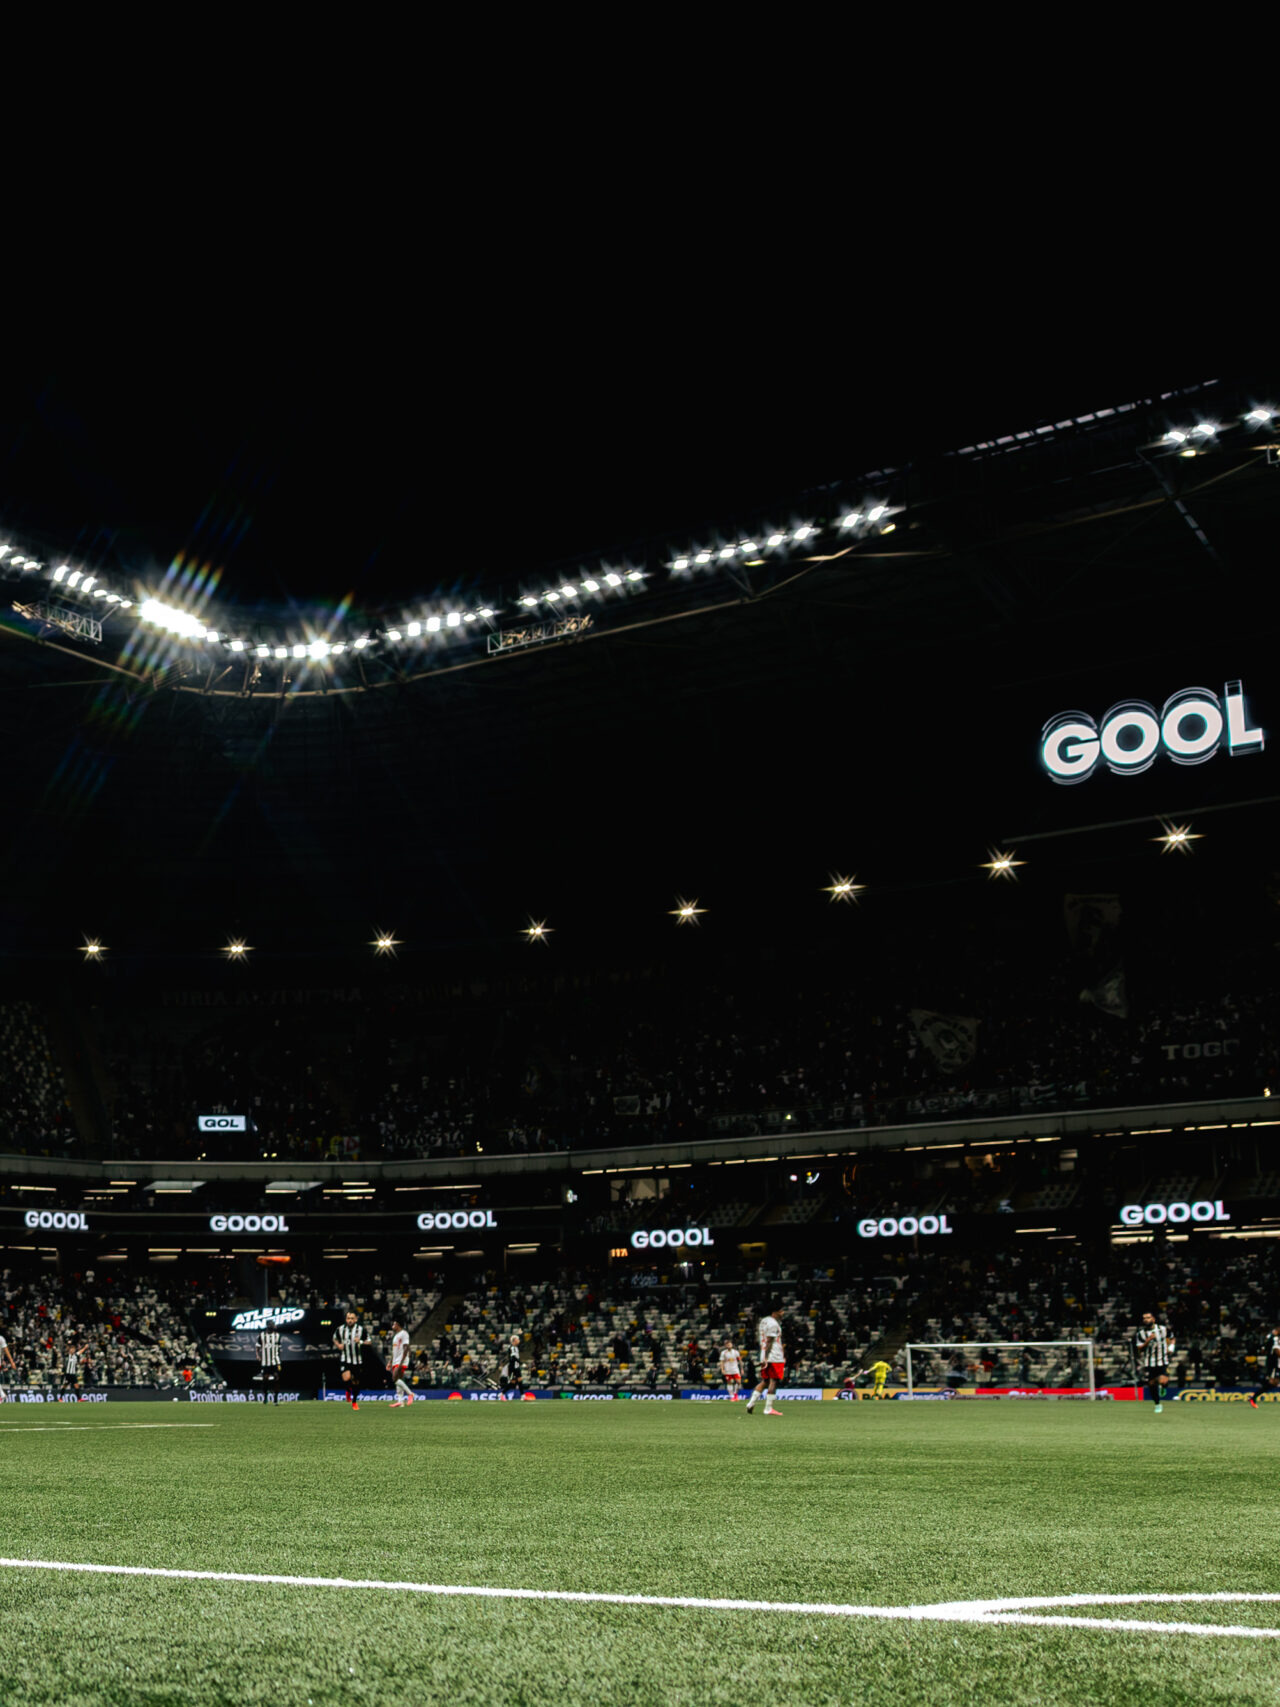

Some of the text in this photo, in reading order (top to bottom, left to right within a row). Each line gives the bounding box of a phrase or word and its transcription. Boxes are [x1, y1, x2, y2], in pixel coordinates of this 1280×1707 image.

[1042, 686, 1264, 780] GOOL
[204, 1118, 239, 1129] GOL
[25, 1210, 89, 1230] GOOOL
[417, 1210, 498, 1230] GOOOL
[1121, 1200, 1231, 1225] GOOOL
[210, 1215, 289, 1232] GOOOL
[858, 1214, 953, 1238] GOOOL
[631, 1227, 714, 1249] GOOOL
[20, 1390, 44, 1403] não
[47, 1389, 55, 1403] é
[189, 1389, 224, 1402] Proibir
[226, 1390, 247, 1402] não
